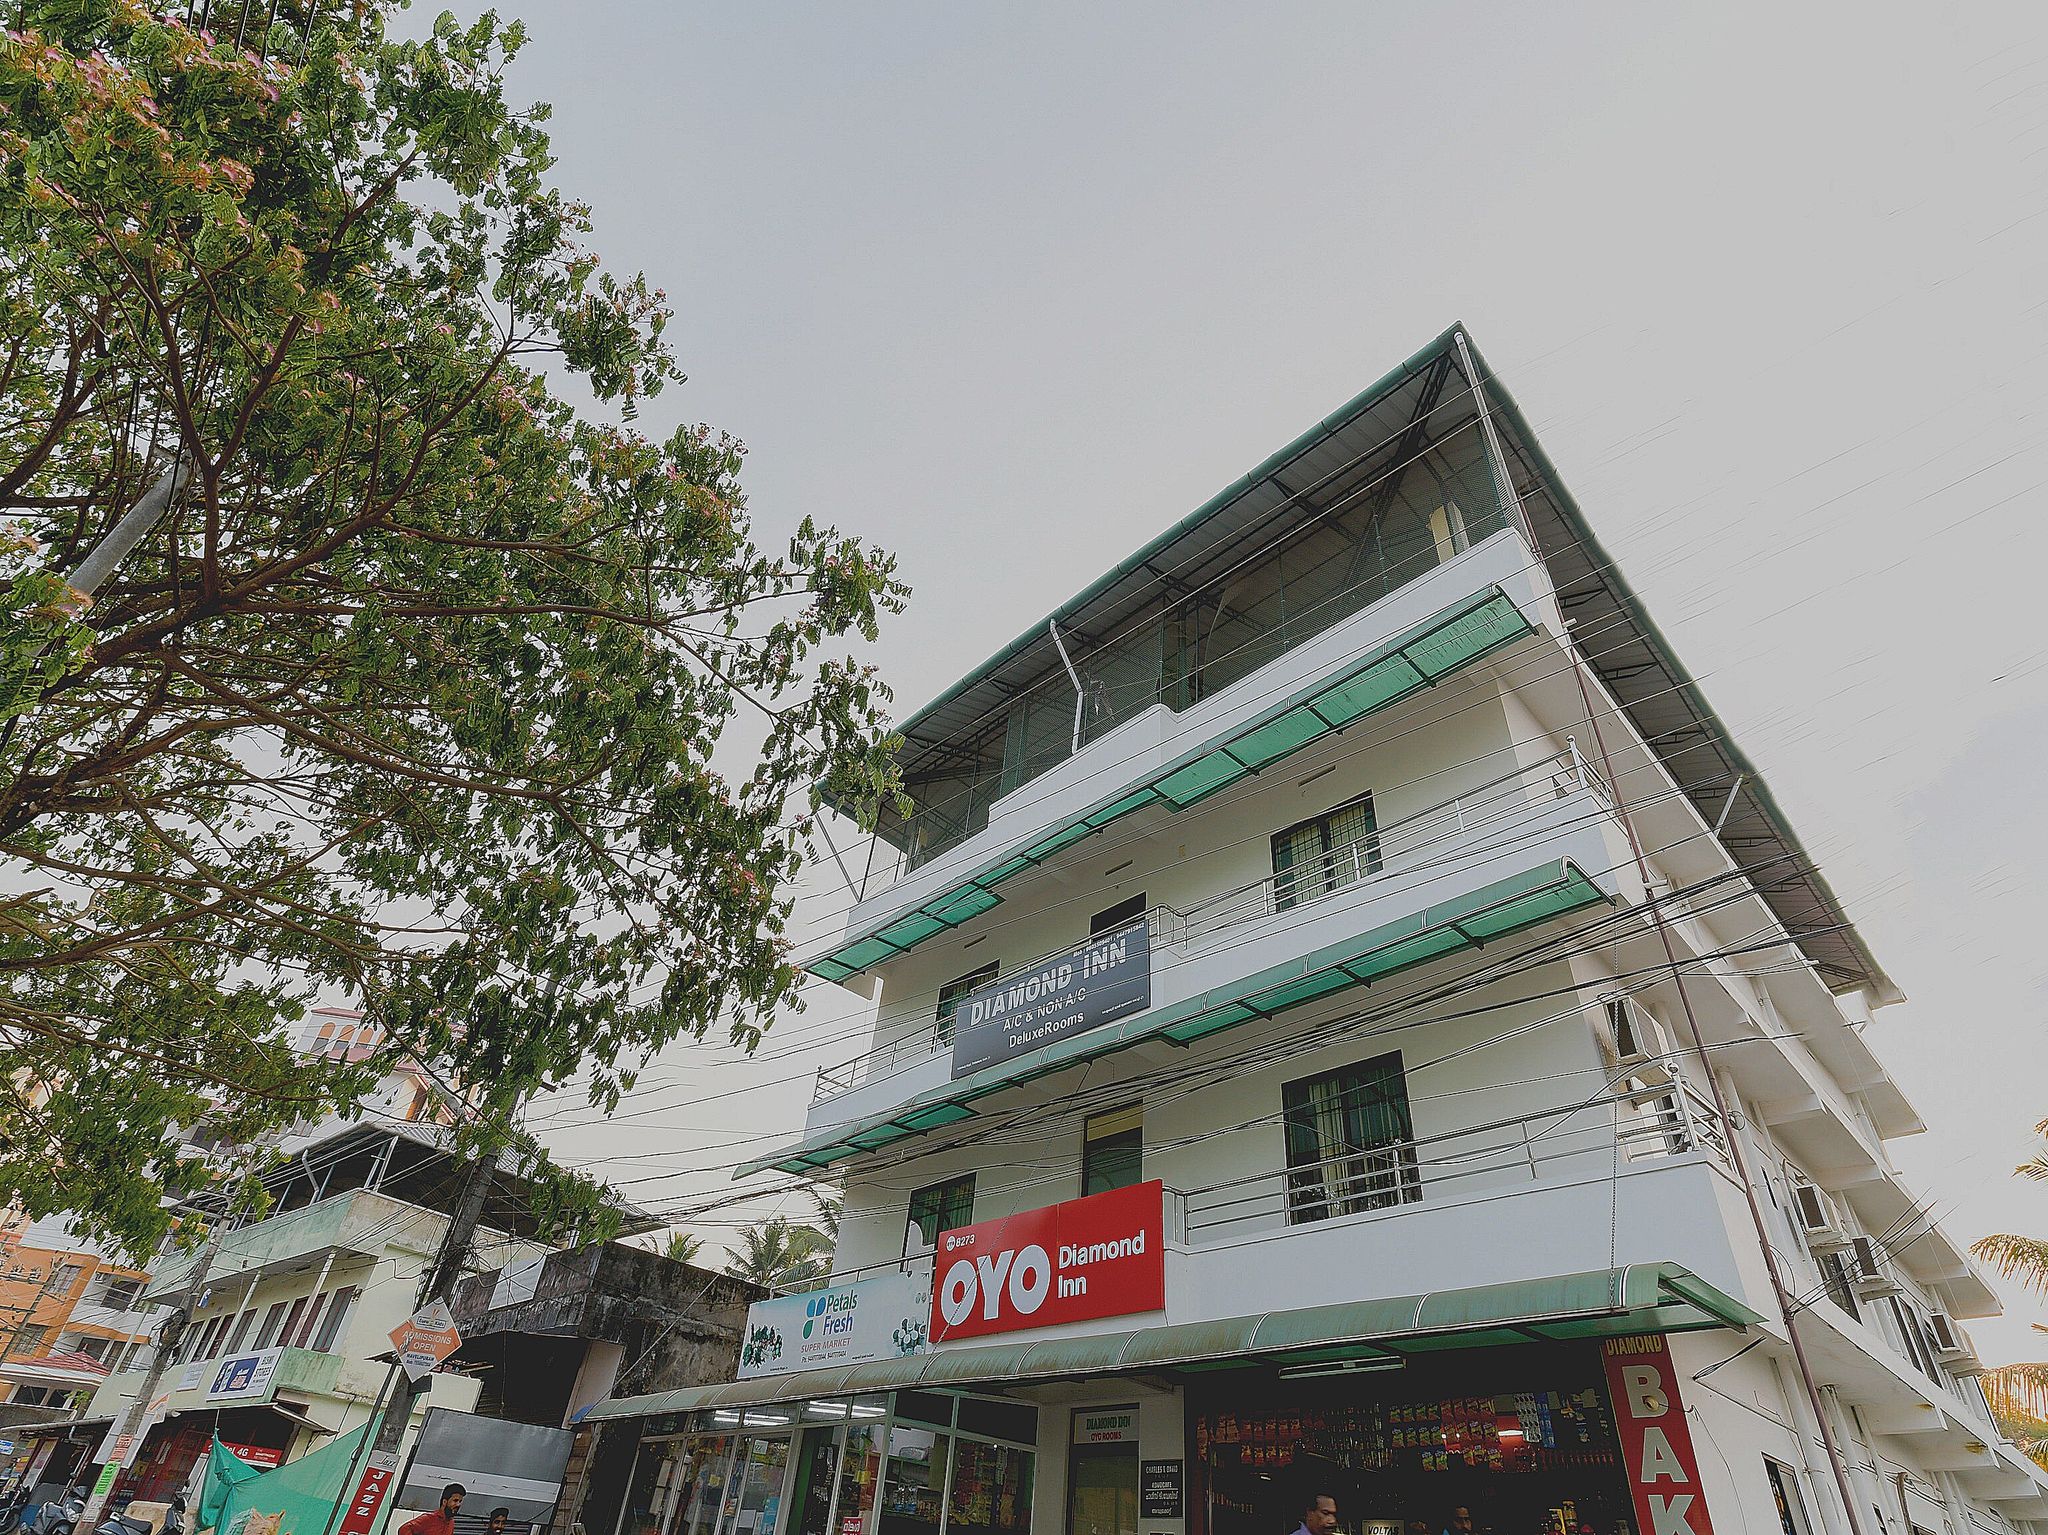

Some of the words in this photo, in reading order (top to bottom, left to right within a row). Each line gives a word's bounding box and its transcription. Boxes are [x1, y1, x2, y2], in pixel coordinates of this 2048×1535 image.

[970, 963, 1073, 1027] DIAMOND
[1082, 938, 1126, 979] INN
[1002, 1014, 1022, 1032] A/C
[1025, 1010, 1033, 1023] &
[1037, 999, 1064, 1019] NON
[1065, 987, 1087, 1007] A/C
[1009, 1012, 1084, 1048] DeluxeRooms
[955, 1234, 975, 1247] 8273
[1058, 1229, 1145, 1270] Diamond
[941, 1244, 1051, 1326] OYO
[1057, 1274, 1087, 1299] Inn
[826, 1289, 858, 1314] Petals
[822, 1315, 853, 1336] Fresh
[401, 1330, 452, 1345] ADMISSIONS
[413, 1341, 437, 1352] OPEN
[800, 1343, 821, 1354] SUPER
[822, 1337, 852, 1349] MARKET
[1605, 1335, 1664, 1356] DIAMOND
[1086, 1416, 1117, 1430] DIAMOND
[1102, 1431, 1122, 1440] ROOMS
[237, 1447, 249, 1457] 4G
[355, 1471, 386, 1517] JAZZ
[1367, 1526, 1400, 1535] VOLTAS
